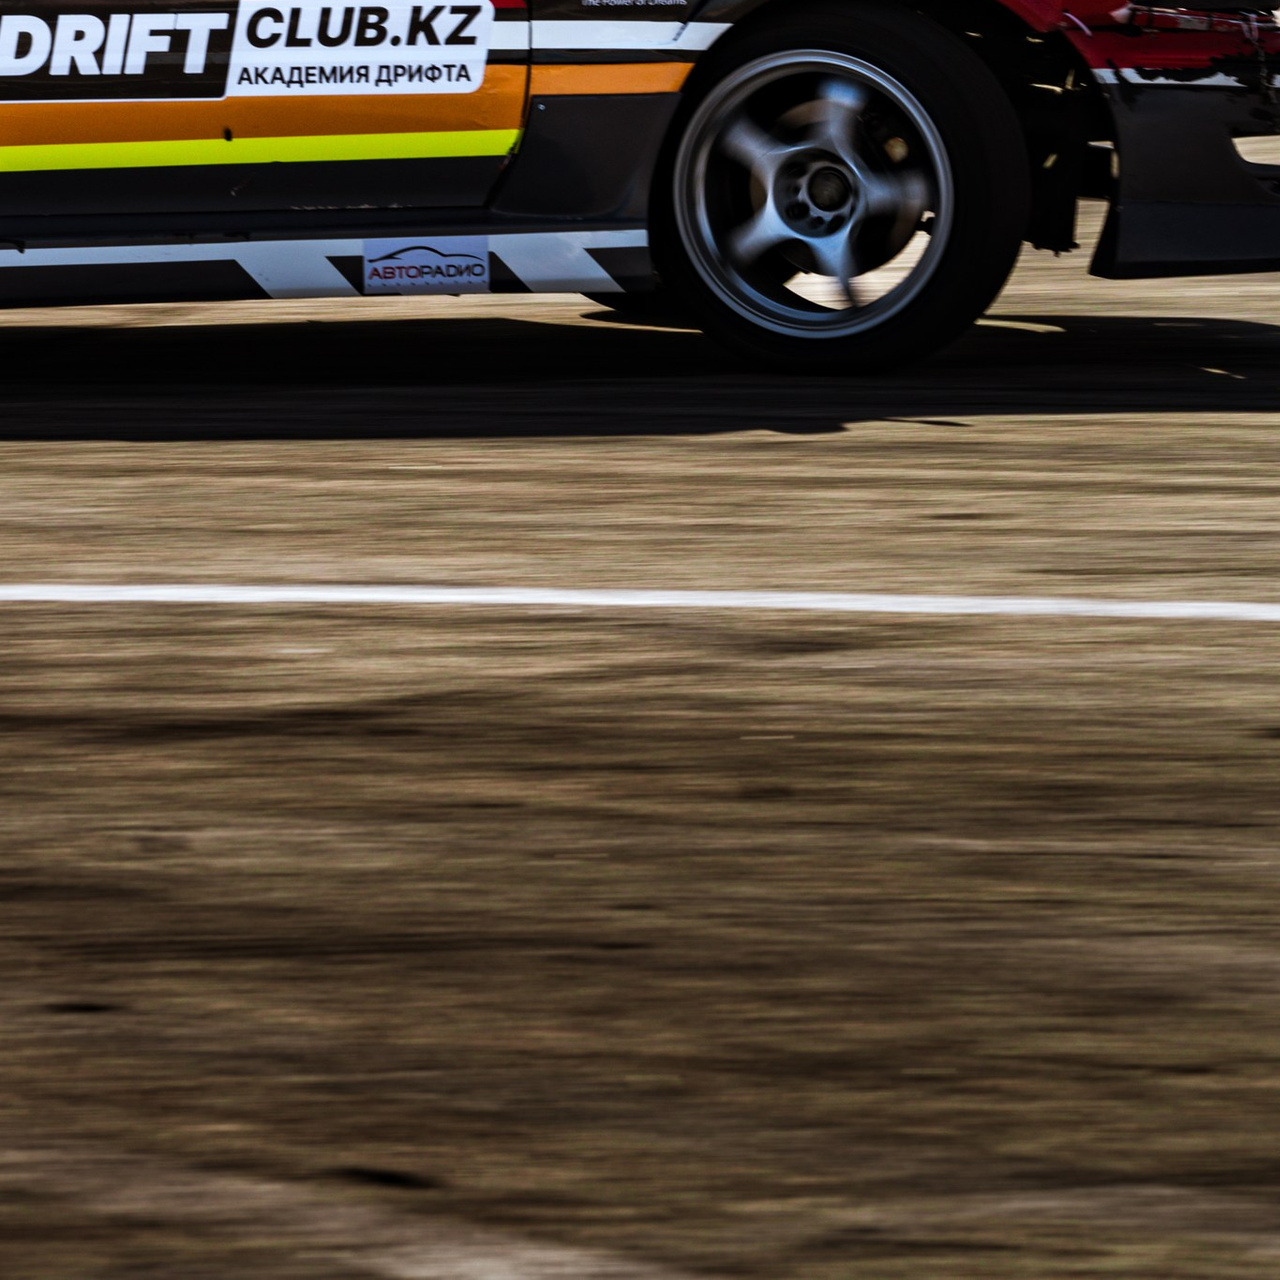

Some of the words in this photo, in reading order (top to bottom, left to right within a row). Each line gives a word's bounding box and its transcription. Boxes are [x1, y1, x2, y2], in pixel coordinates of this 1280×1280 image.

[246, 5, 482, 48] CLUB.KZ
[238, 65, 370, 88] АКАДЕМИЯ
[375, 64, 472, 86] ДРИФТА
